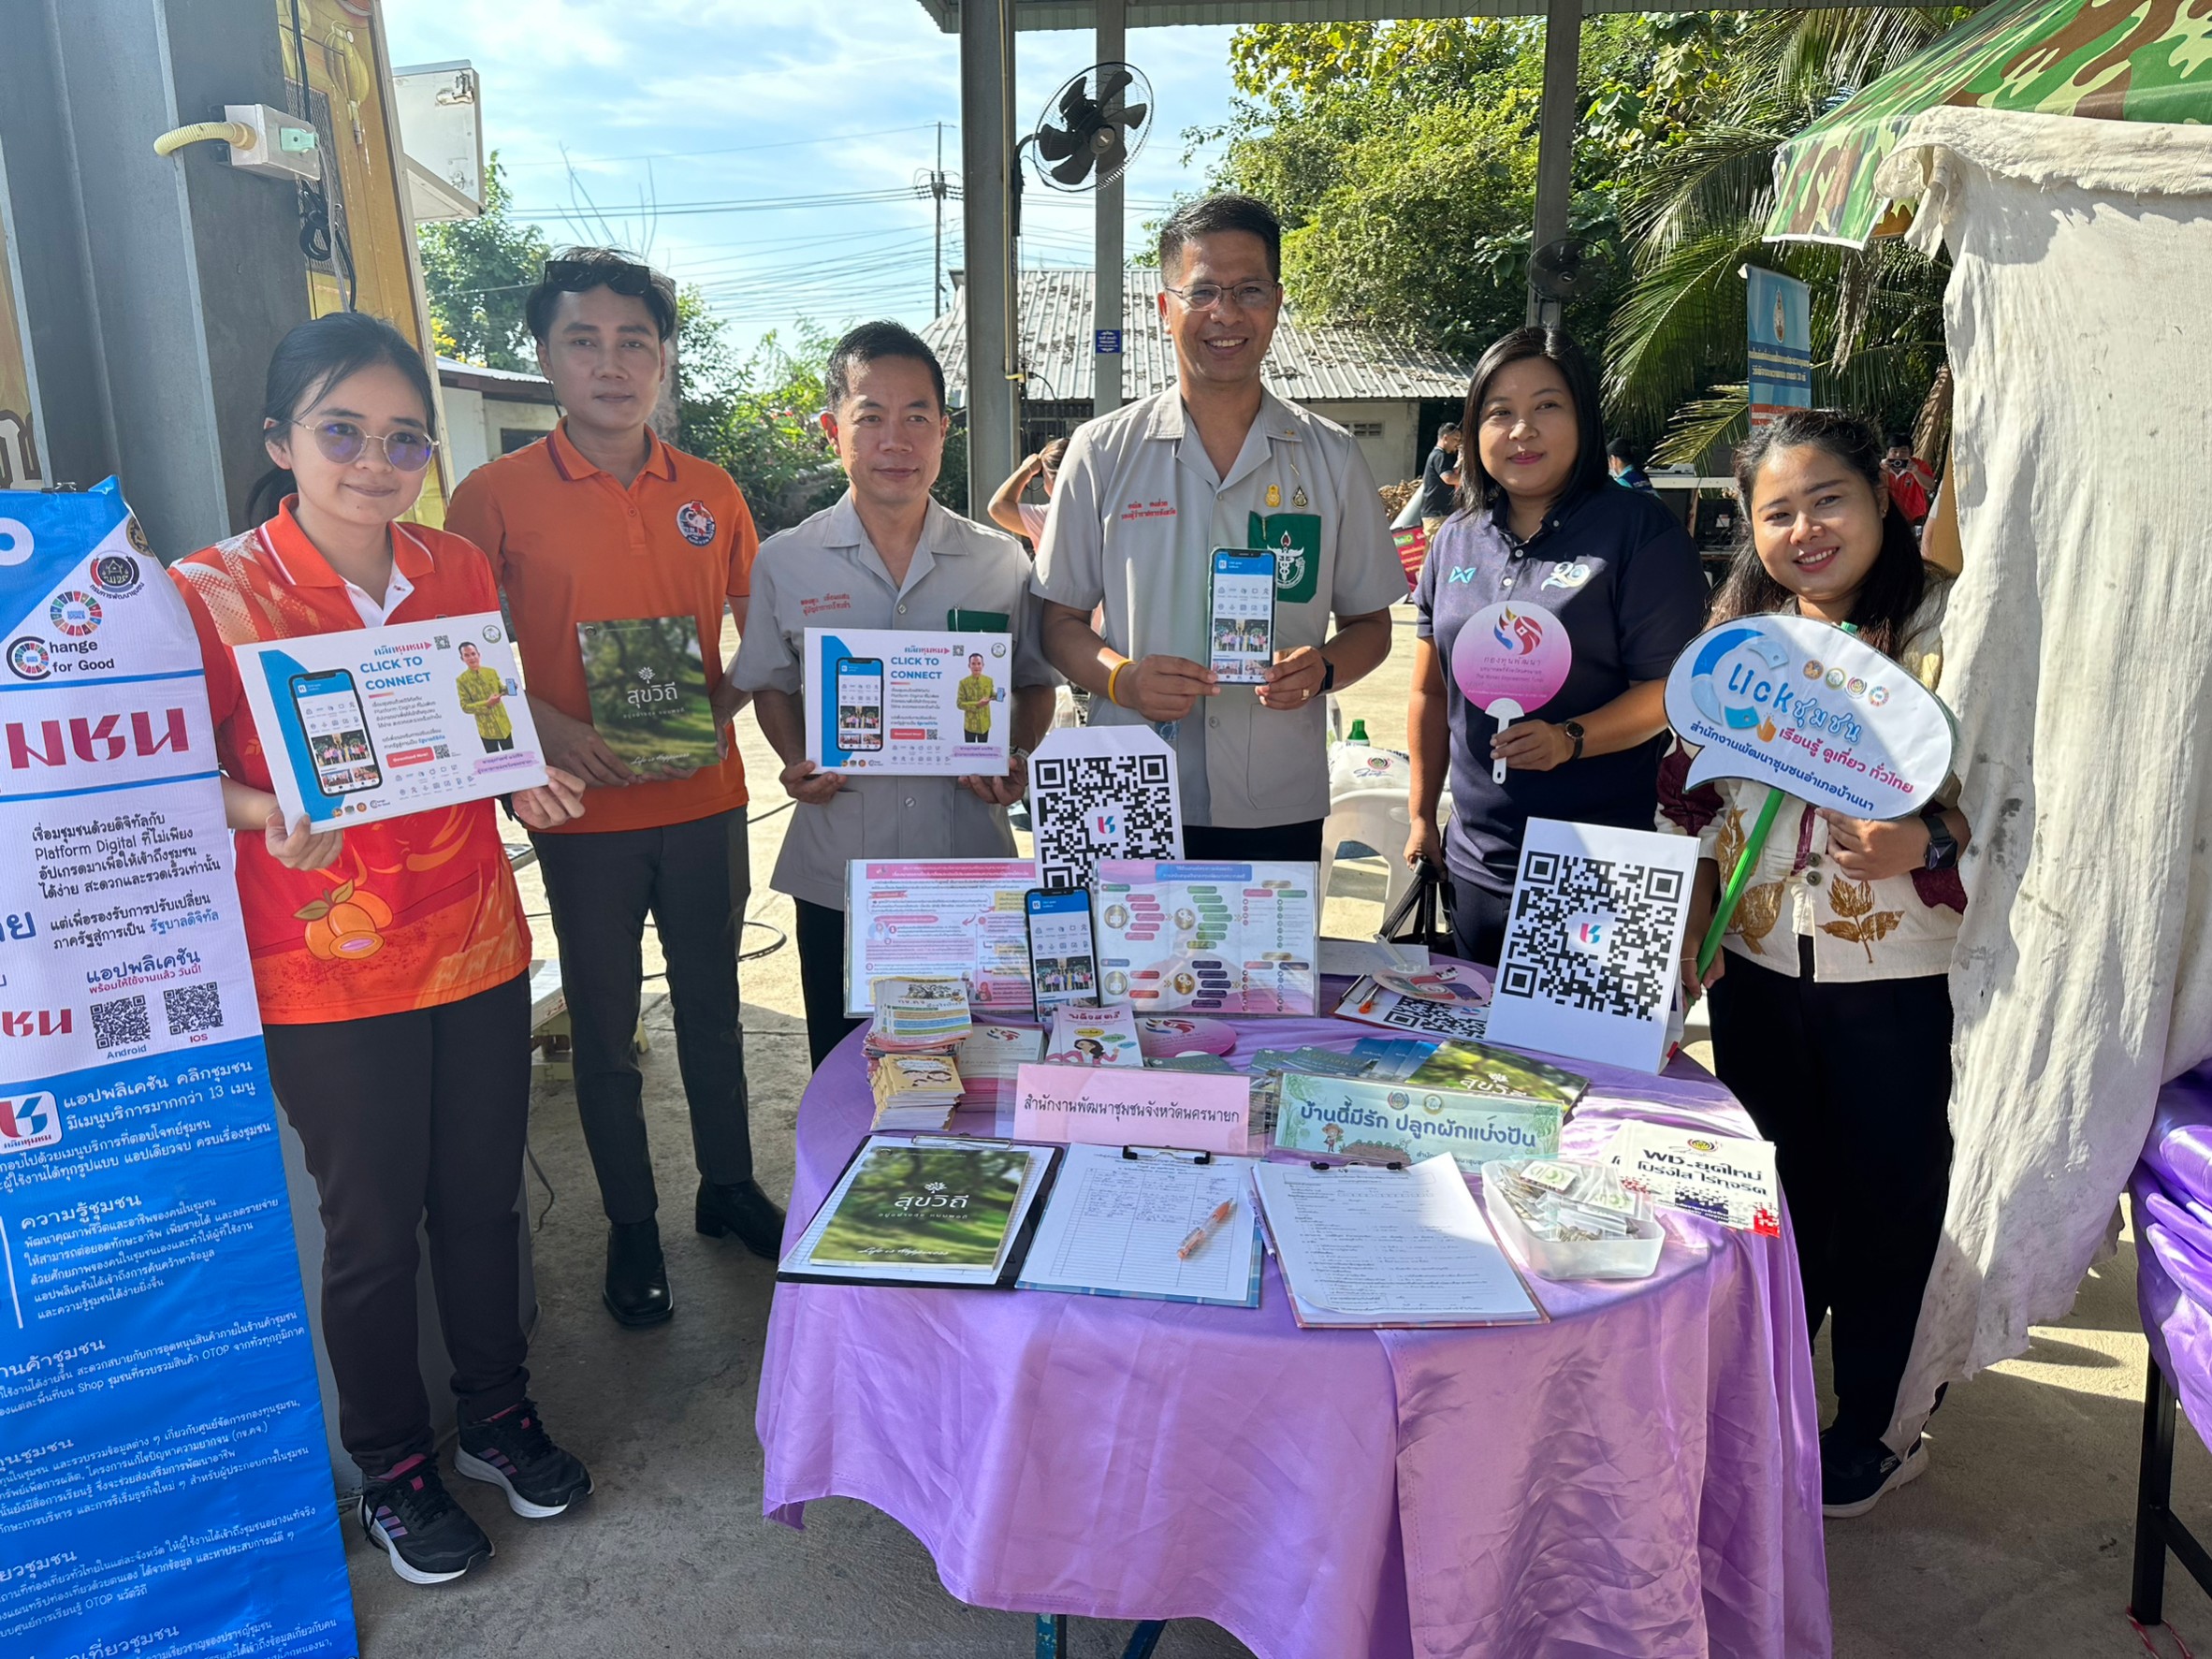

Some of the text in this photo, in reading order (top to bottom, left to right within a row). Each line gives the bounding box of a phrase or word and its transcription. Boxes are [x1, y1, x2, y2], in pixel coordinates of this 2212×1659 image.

[52, 658, 115, 674] for Good
[360, 656, 423, 674] CLICK TO
[891, 657, 922, 665] CLICK
[891, 671, 942, 679] CONNECT
[365, 672, 431, 691] CONNECT
[627, 681, 679, 709] สุขวิถี
[1792, 697, 1863, 745] ชุมชน
[1690, 721, 1874, 811] สำนักงานพัฒนาชุมชนอำเภอบ้านนา
[1779, 726, 1914, 794] เรียนรู้ ดูเที่ยว ทั่วไทย
[32, 811, 166, 844] เชื่อมชุมชนด้วยดิจิทัลกับ
[35, 826, 194, 861] Platform Digital ที่ไม่เพียง
[38, 853, 221, 900] ได้ง่าย สะดวกและรวดเร็วเท่านั้น
[51, 889, 211, 931] แต่เพื่อรองรับการปรับเปลี่ยน
[53, 908, 220, 949] ภาครัฐสู่การเป็น รัฐบาลดิจิทัล
[87, 947, 201, 983] แอปพลิเคชัน
[89, 961, 202, 995] พร้อมให้ใช้งานแล้ว วันนี้!
[107, 1044, 148, 1059] Android
[64, 1059, 253, 1109] แอปพลิเคชัน คลิกชุมชน
[67, 1080, 256, 1131] มีเมนูบริการมากกว่า 13 เมนู
[1024, 1093, 1241, 1124] สำนักงานพัฒนาชุมชนจังหวัดนครนายก
[1300, 1097, 1536, 1148] บ้านนี้มีรัก ปลูกผักแบ่งปัน
[124, 1141, 192, 1164] แอปเดียวจบ
[196, 1122, 271, 1149] ครบเรื่องชุมชน
[22, 1192, 142, 1230] ความรู้ชุมชน
[166, 1212, 211, 1235] เพิ่มรายได้
[214, 1198, 279, 1222] และลดรายจ่าย
[894, 1194, 969, 1213] สุขวิถี
[79, 1379, 104, 1392] Shop
[202, 1345, 230, 1360] OTOP
[85, 1594, 113, 1609] OTOP
